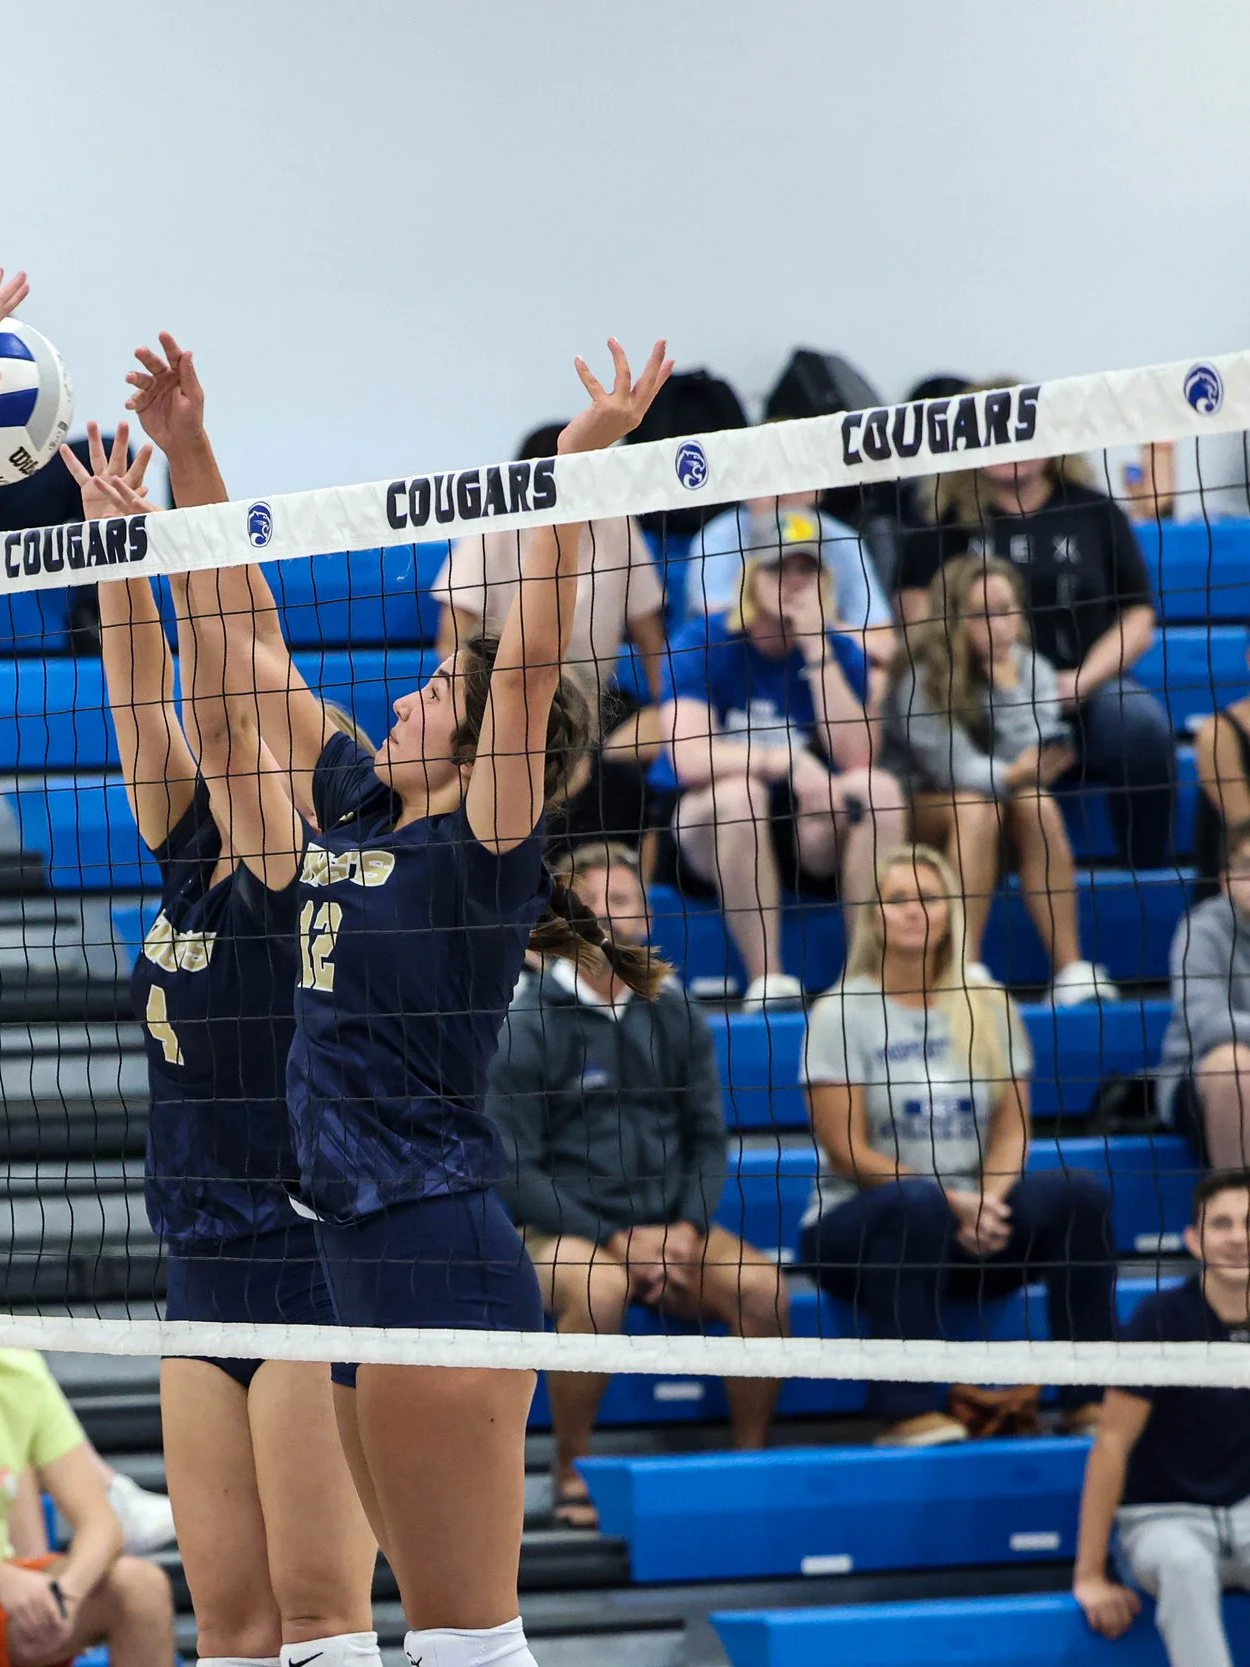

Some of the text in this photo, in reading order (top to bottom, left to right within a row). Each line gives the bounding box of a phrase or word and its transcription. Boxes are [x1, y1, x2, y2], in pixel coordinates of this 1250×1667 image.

[841, 385, 1041, 466] COUGARS
[387, 459, 557, 530] COUGARS
[5, 515, 147, 578] COUGARS
[296, 900, 344, 992] 12
